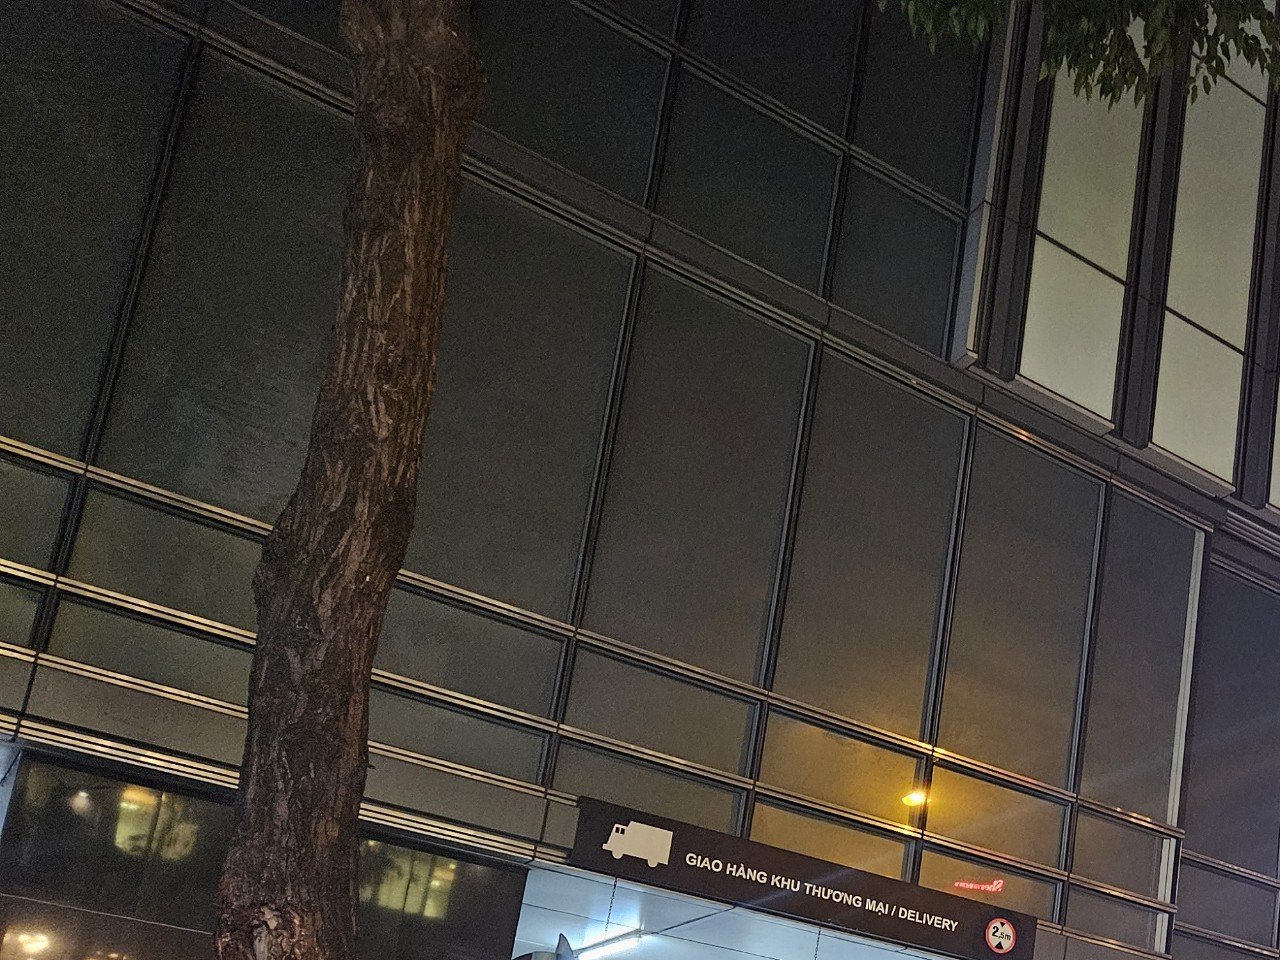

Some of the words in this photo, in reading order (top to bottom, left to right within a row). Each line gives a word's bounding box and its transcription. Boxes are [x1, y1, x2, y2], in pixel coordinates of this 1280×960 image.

[685, 852, 723, 872] GIAO
[726, 862, 768, 884] HÀNG
[770, 874, 801, 892] KHU
[804, 882, 862, 908] THƯƠNG
[865, 898, 889, 916] MẠI
[898, 907, 959, 932] DELIVERY
